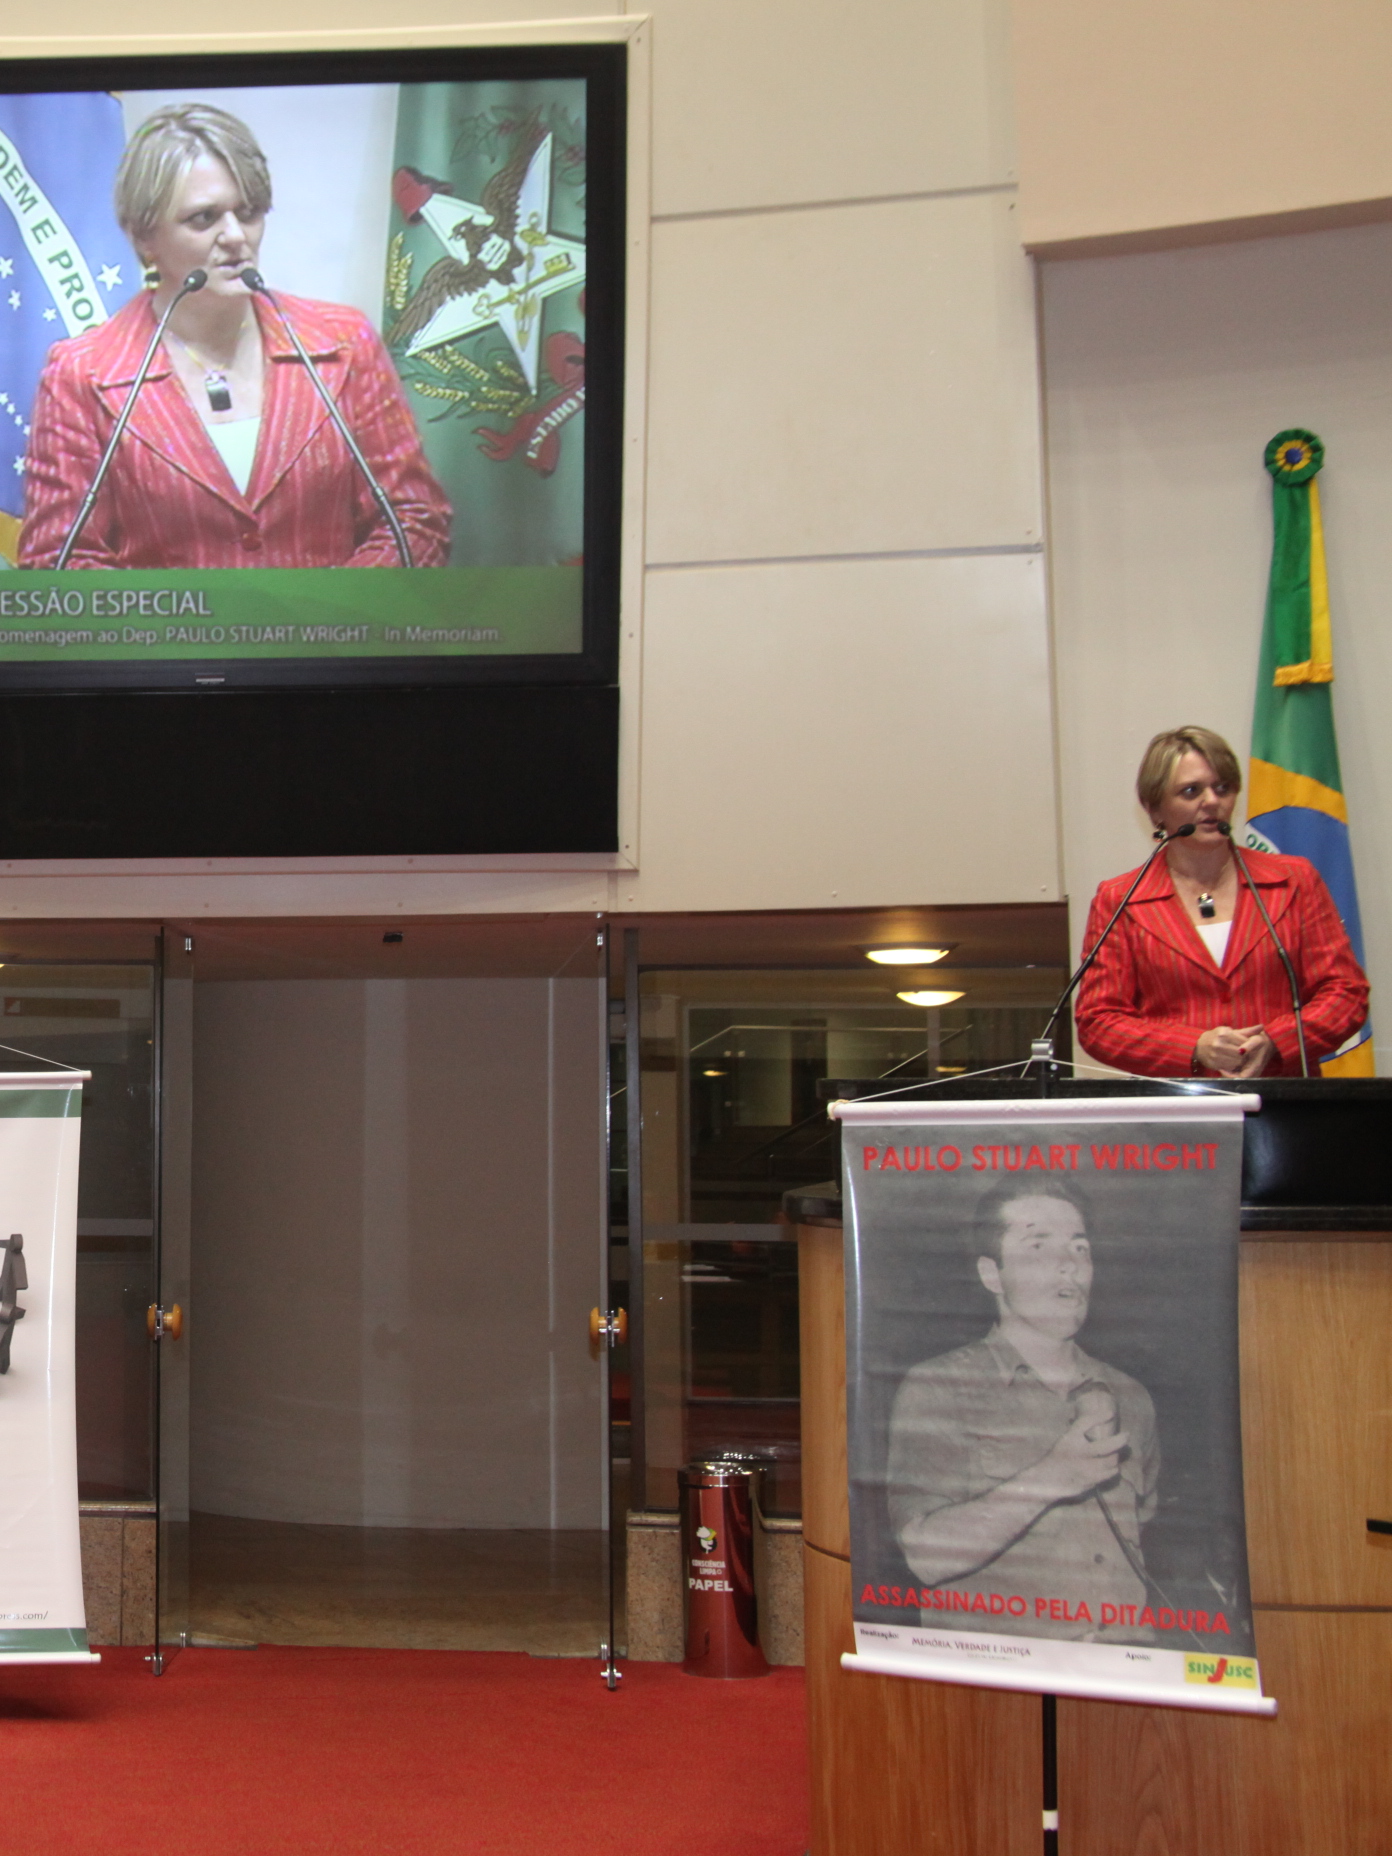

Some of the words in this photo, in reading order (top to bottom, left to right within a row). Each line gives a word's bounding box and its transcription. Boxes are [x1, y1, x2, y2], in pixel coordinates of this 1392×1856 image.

[31, 218, 58, 245] E
[47, 249, 99, 335] PRO
[91, 590, 212, 616] ESPECIAL
[97, 630, 118, 643] ao
[122, 626, 161, 646] Dep.
[166, 626, 225, 643] PAULO
[230, 626, 296, 642] STUART
[300, 625, 369, 642] WRIGHT
[385, 626, 401, 641] In
[863, 1144, 962, 1172] PAULO
[971, 1144, 1081, 1172] STUART
[1089, 1143, 1219, 1171] WRIGHT
[688, 1578, 734, 1592] PAPEL
[860, 1584, 1027, 1617] ASSASSINADO
[1034, 1597, 1092, 1623] PELA
[1101, 1603, 1231, 1635] DITADURA
[954, 1641, 990, 1653] VERDADE
[1000, 1646, 1031, 1657] JUSTIÇA
[1187, 1657, 1254, 1683] SINJUSC
